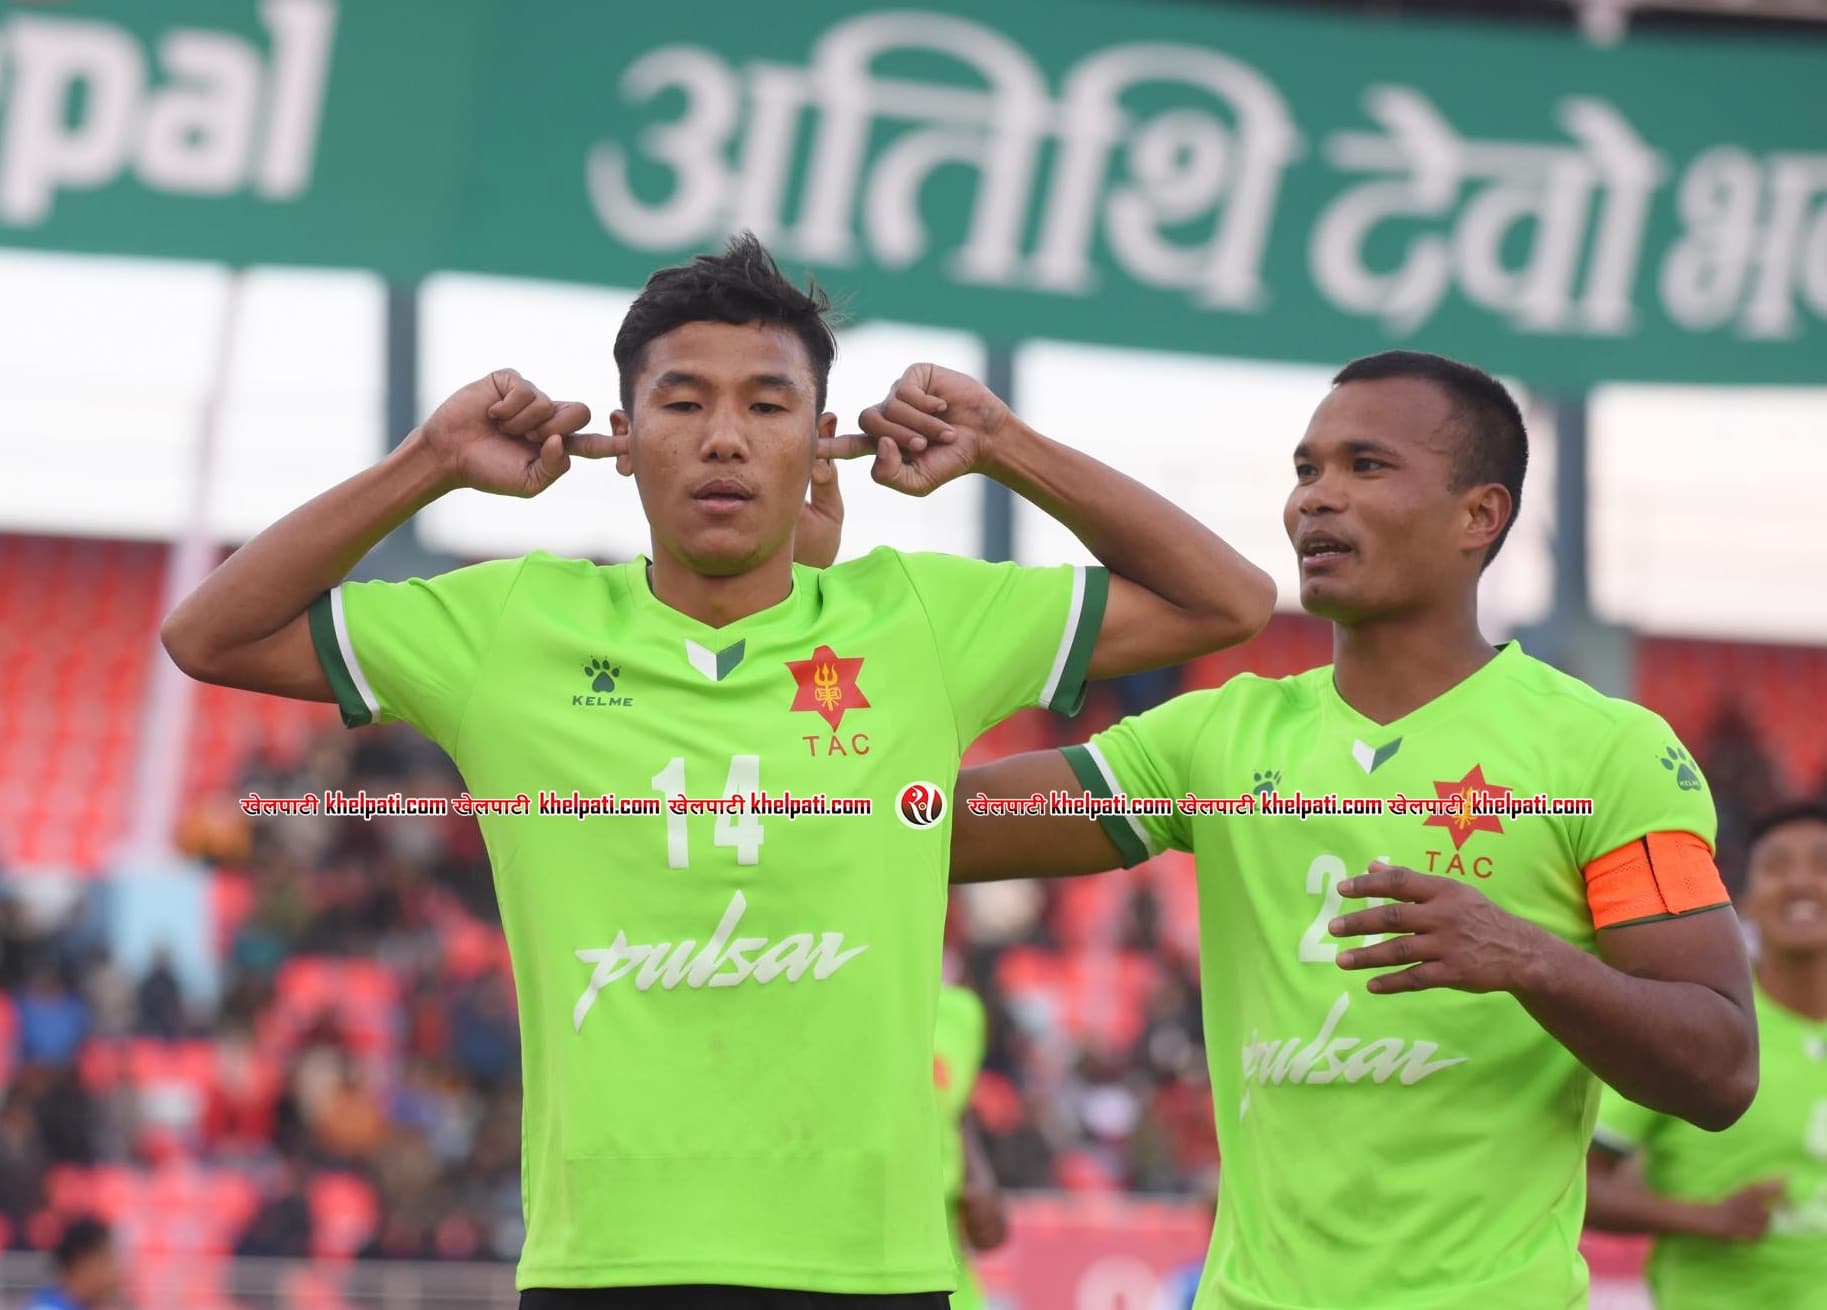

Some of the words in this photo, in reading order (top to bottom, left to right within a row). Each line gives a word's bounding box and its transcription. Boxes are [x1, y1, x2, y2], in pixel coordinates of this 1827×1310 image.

[0, 0, 337, 228] pal
[587, 10, 1305, 312] अतिथि
[1308, 85, 1663, 336] देवो
[1657, 143, 1827, 342] भ
[572, 695, 634, 707] KELME
[802, 733, 870, 757] TAC
[651, 755, 764, 869] 14
[1425, 851, 1494, 879] TAC
[573, 889, 869, 1033] pulsar
